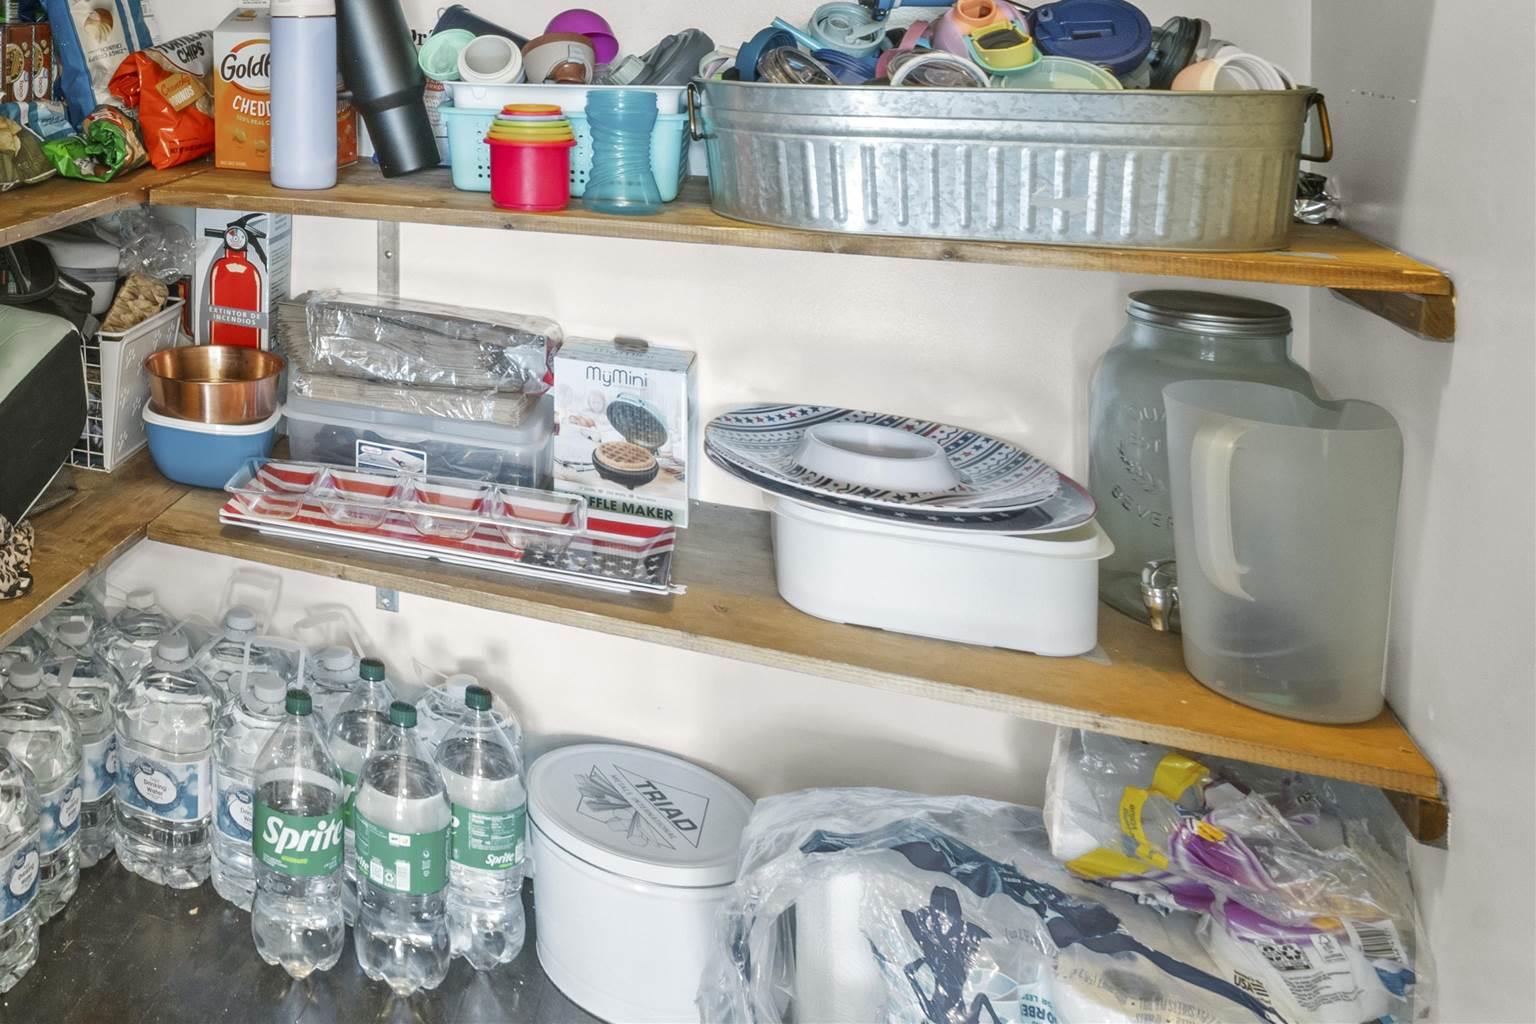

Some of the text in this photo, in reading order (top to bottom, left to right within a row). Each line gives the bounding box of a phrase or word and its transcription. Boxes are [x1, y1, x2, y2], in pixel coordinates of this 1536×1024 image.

[176, 41, 205, 63] CHIPS
[220, 54, 271, 81] Goldf
[208, 306, 249, 318] EXTINTOR
[213, 314, 256, 325] INCENDIOS
[585, 365, 648, 387] MyMini
[584, 495, 674, 521] FFLE MAKER
[143, 779, 168, 792] Drinking
[146, 787, 165, 796] Water
[635, 780, 698, 831] TRIAD
[262, 815, 345, 854] Sprite
[485, 852, 515, 866] Sprite
[1233, 973, 1253, 993] USA
